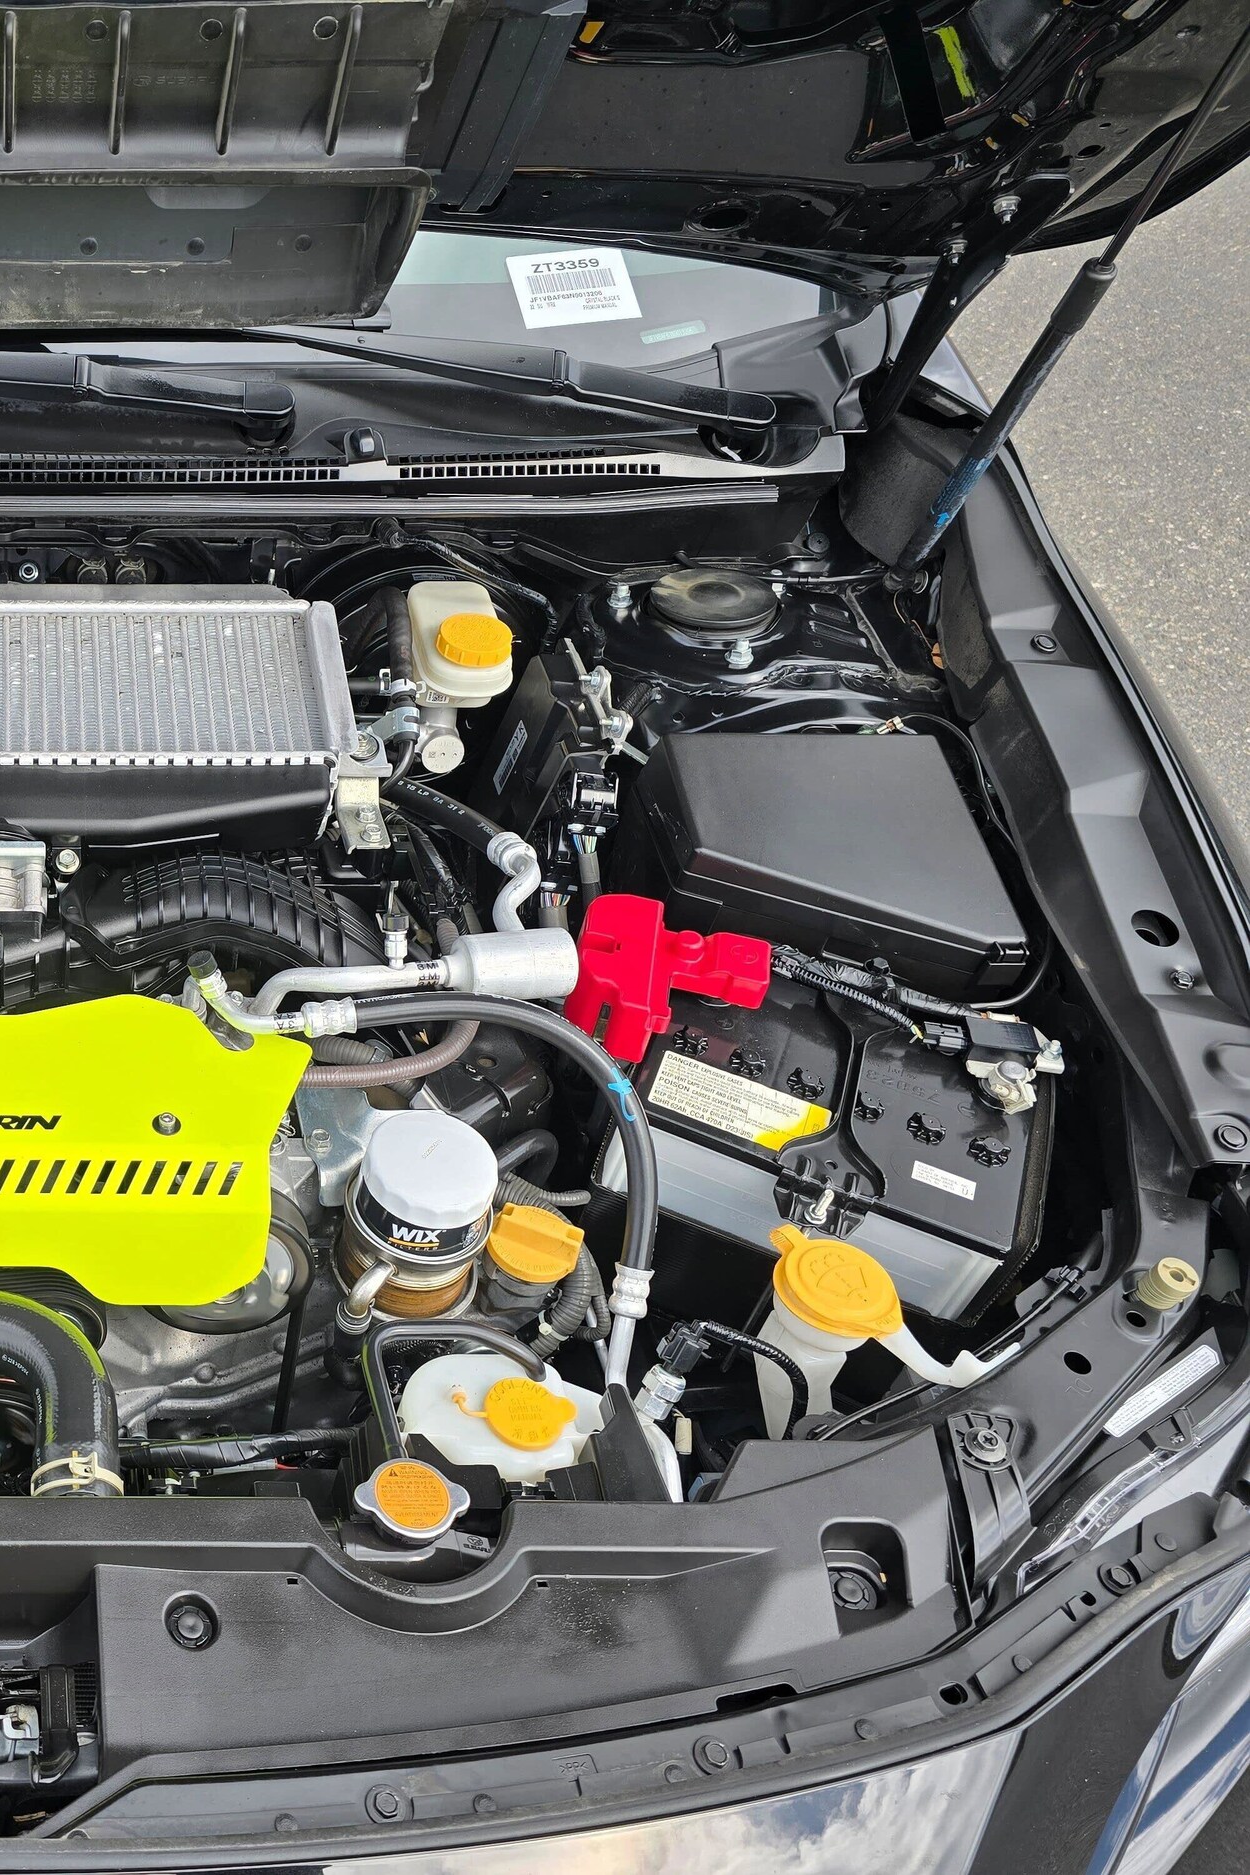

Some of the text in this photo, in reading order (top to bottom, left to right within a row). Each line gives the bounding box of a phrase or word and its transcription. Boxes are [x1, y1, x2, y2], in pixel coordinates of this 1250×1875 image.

[531, 258, 600, 273] ZT3359
[666, 1053, 699, 1070] DANGER
[658, 1075, 690, 1092] POISON
[691, 1089, 711, 1100] CAUSES
[711, 1096, 730, 1107] SEVERE
[660, 1070, 673, 1078] KEEP
[673, 1074, 686, 1083] VENT
[686, 1079, 700, 1088] CAPS
[726, 1094, 742, 1104] LEVEL
[650, 1095, 670, 1107] 20HR
[653, 1089, 666, 1097] KEEP
[684, 1101, 702, 1111] REACH
[709, 1110, 734, 1123] CHILDREN
[392, 1223, 443, 1243] WIX
[489, 1380, 549, 1400] COOLANT
